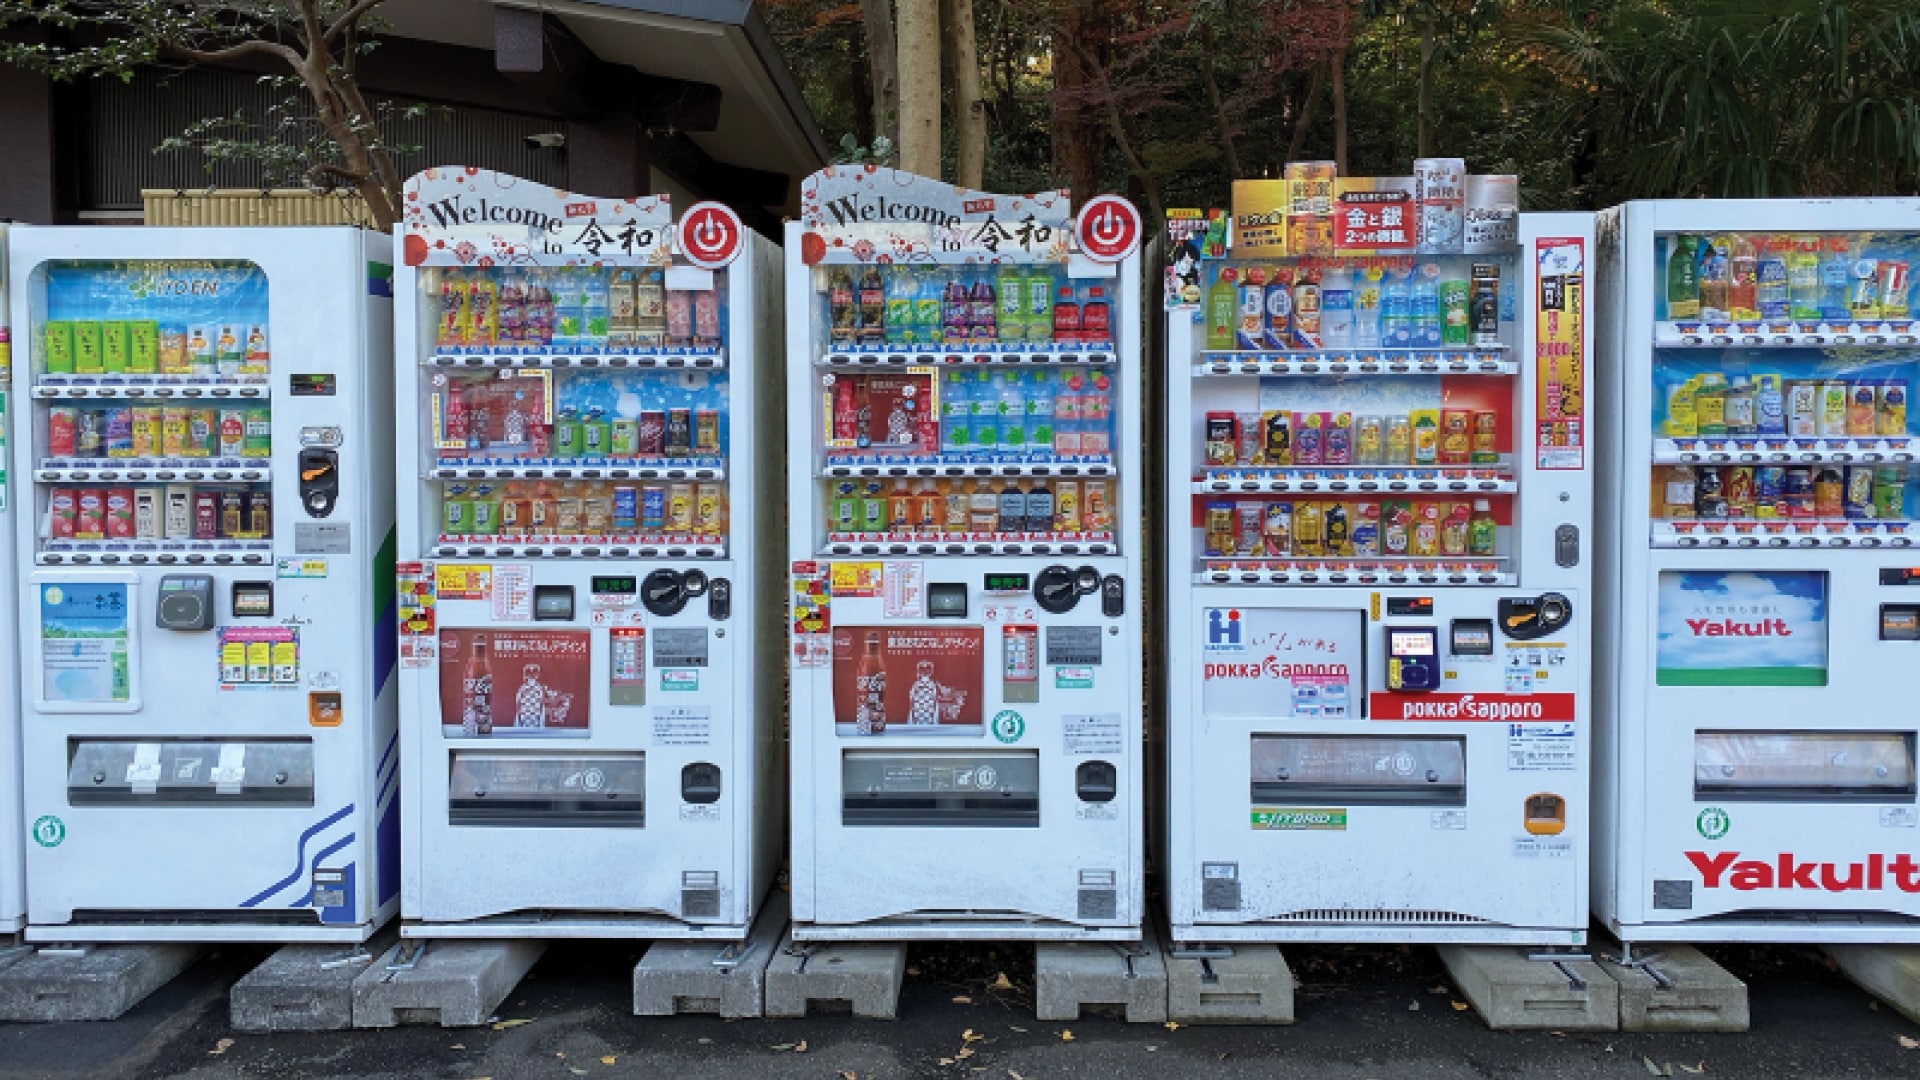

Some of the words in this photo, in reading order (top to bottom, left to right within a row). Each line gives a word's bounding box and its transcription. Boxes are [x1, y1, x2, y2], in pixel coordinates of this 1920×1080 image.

[427, 194, 563, 235] Welcome
[826, 193, 961, 229] Welcome
[543, 239, 563, 255] to
[572, 217, 653, 257] 令和
[942, 237, 961, 251] to
[971, 212, 1051, 254] 令和
[191, 279, 219, 295] EN
[1685, 618, 1793, 637] Yakult
[1682, 850, 1920, 893] Yakult
